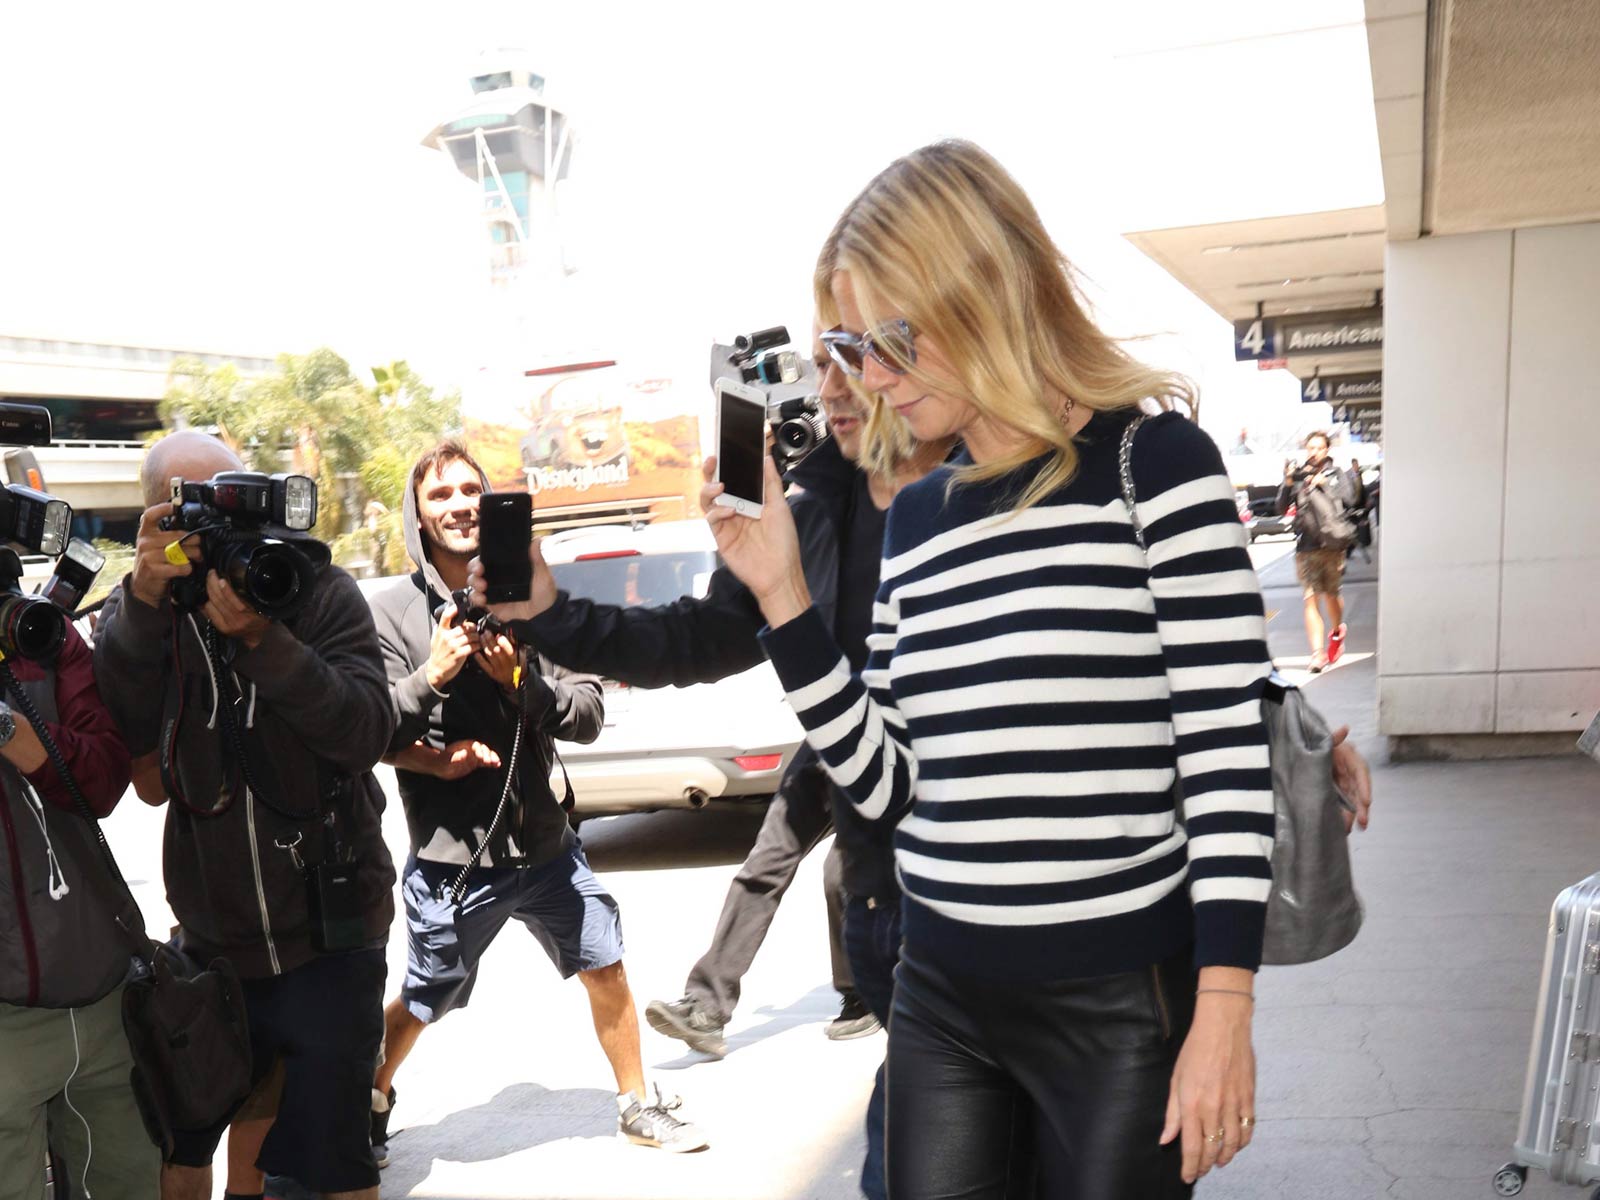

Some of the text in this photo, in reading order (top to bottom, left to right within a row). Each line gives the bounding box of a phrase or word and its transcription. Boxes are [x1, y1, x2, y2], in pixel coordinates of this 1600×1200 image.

[1241, 319, 1265, 355] 4
[1303, 378, 1321, 400] 4
[1333, 404, 1347, 422] 4
[522, 455, 630, 495] Disneyland
